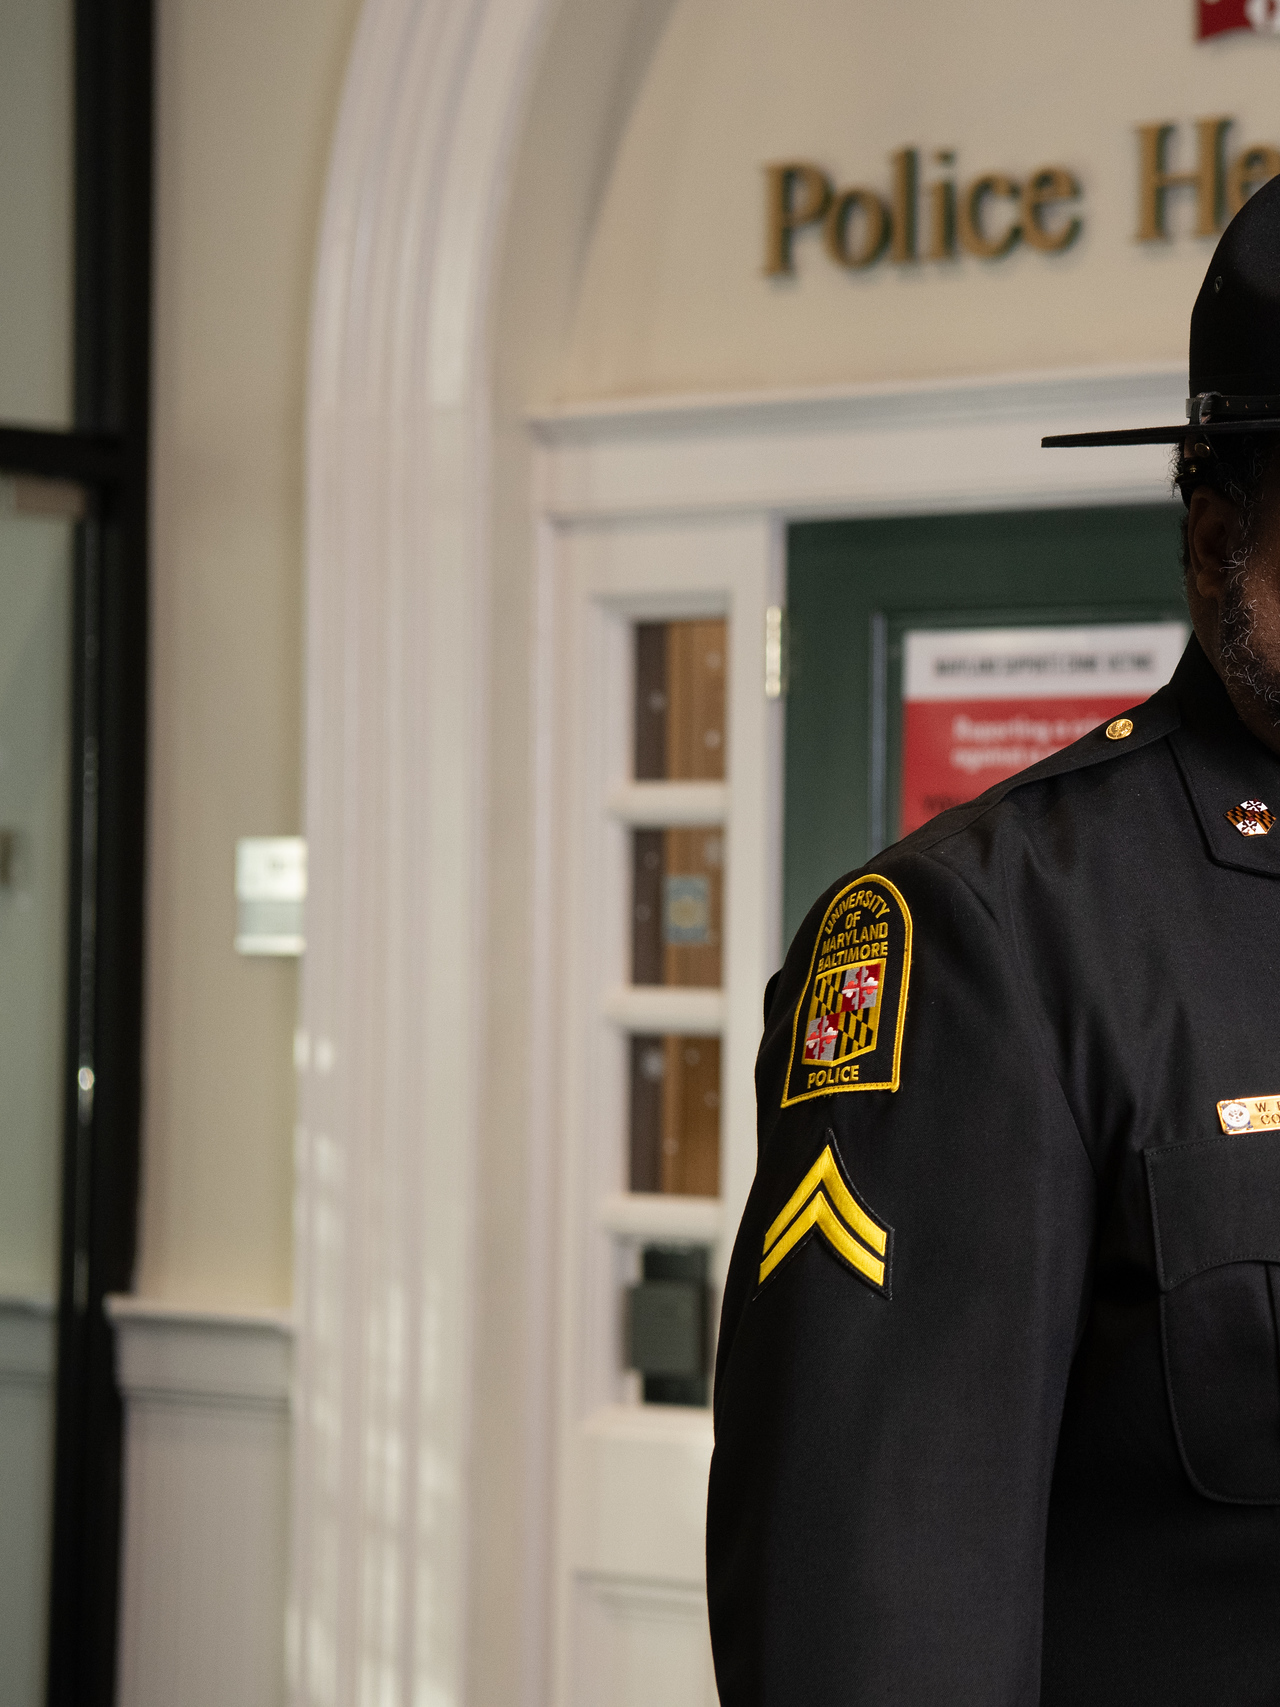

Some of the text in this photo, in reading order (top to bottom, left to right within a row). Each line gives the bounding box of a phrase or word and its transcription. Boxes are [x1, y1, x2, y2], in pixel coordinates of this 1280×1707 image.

[762, 146, 1083, 276] Police
[824, 889, 890, 934] UNIVERSITY
[845, 911, 862, 931] OF
[821, 922, 889, 956] MARYLAND
[817, 941, 889, 974] BALTIMORE
[807, 1065, 860, 1089] POLICE
[1255, 1102, 1270, 1113] W.
